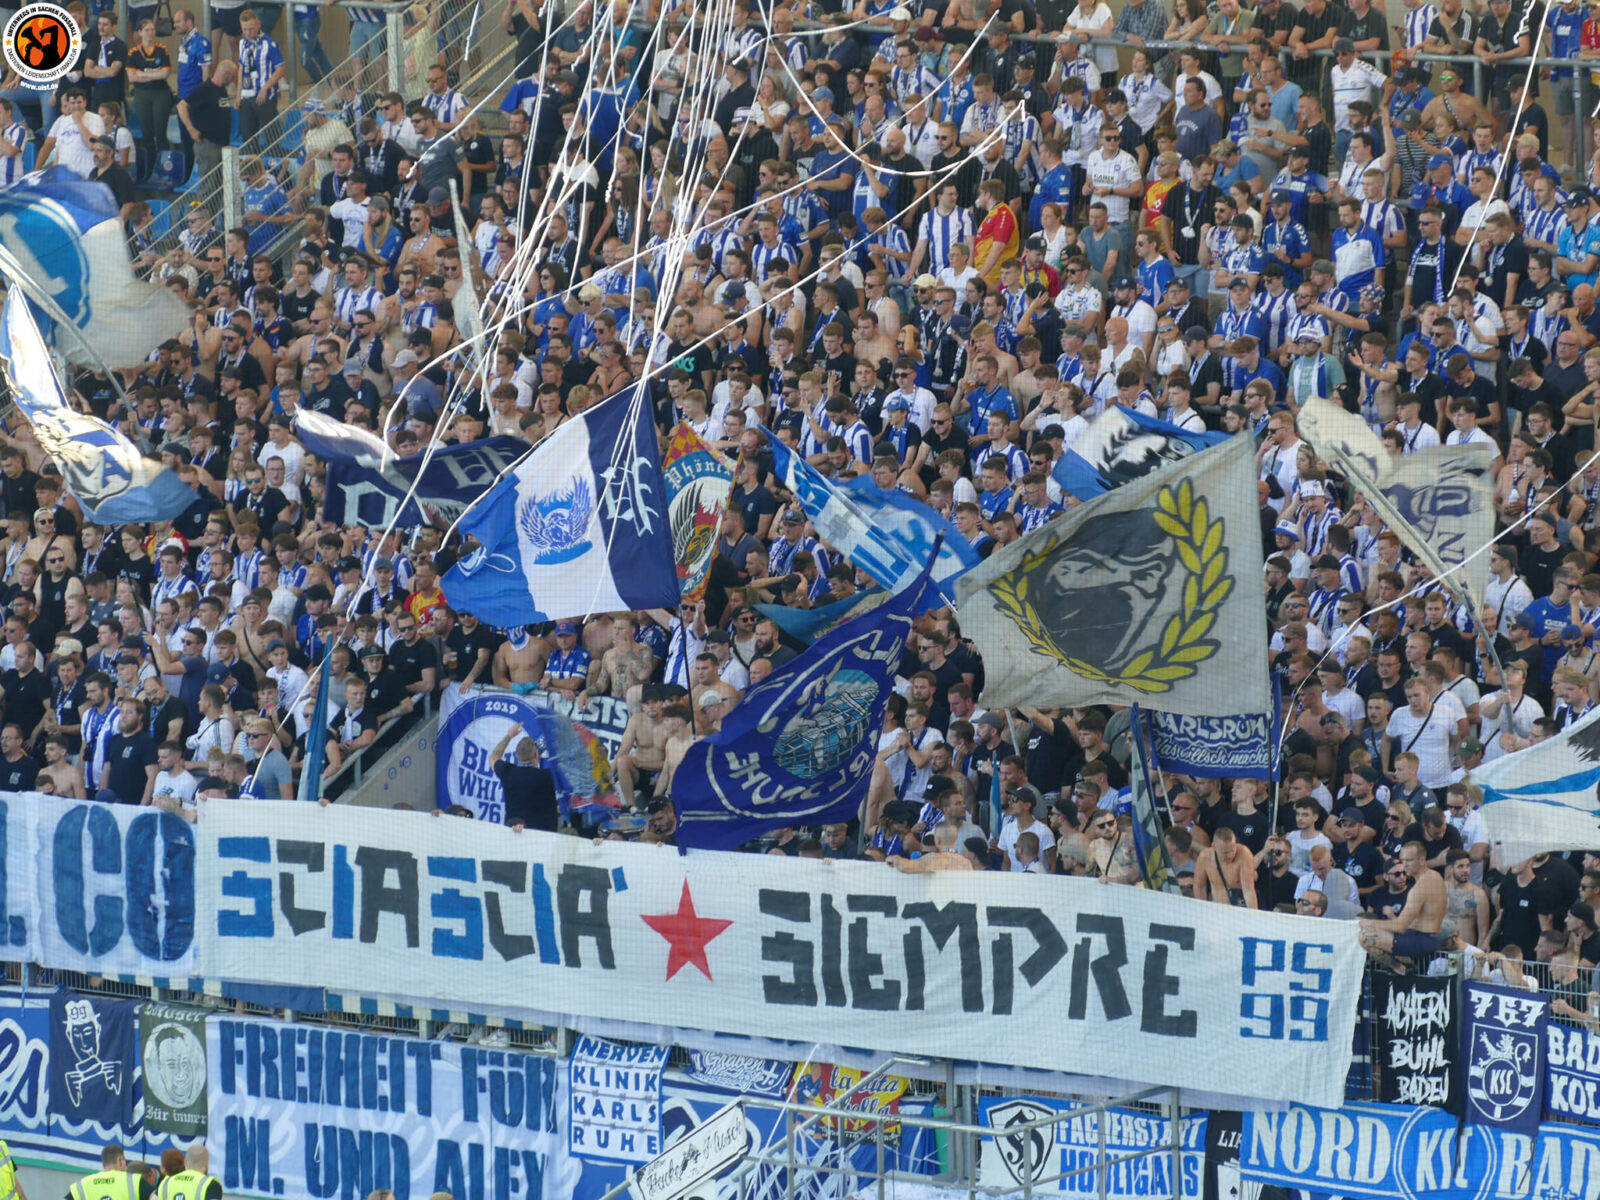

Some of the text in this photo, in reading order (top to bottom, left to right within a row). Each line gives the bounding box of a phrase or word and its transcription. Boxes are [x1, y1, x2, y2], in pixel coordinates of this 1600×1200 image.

[485, 700, 518, 715] 2019
[759, 889, 1198, 1037] SIEMPRE
[1240, 937, 1334, 994] PS
[70, 1005, 87, 1020] 99
[1240, 992, 1329, 1042] 99
[1379, 980, 1450, 1035] ACHERN
[1468, 988, 1547, 1028] 767
[579, 1037, 666, 1064] NERVEN
[1387, 1033, 1451, 1074] BÜHL
[219, 1020, 559, 1134] FREIHEIT FÜR
[573, 1065, 658, 1092] KLINIK
[1489, 1069, 1514, 1095] KSC
[573, 1096, 657, 1123] KARLS
[573, 1126, 658, 1155] RUHE
[1248, 1106, 1391, 1185] NORD
[1416, 1127, 1474, 1192] KSC
[304, 1123, 410, 1200] UND
